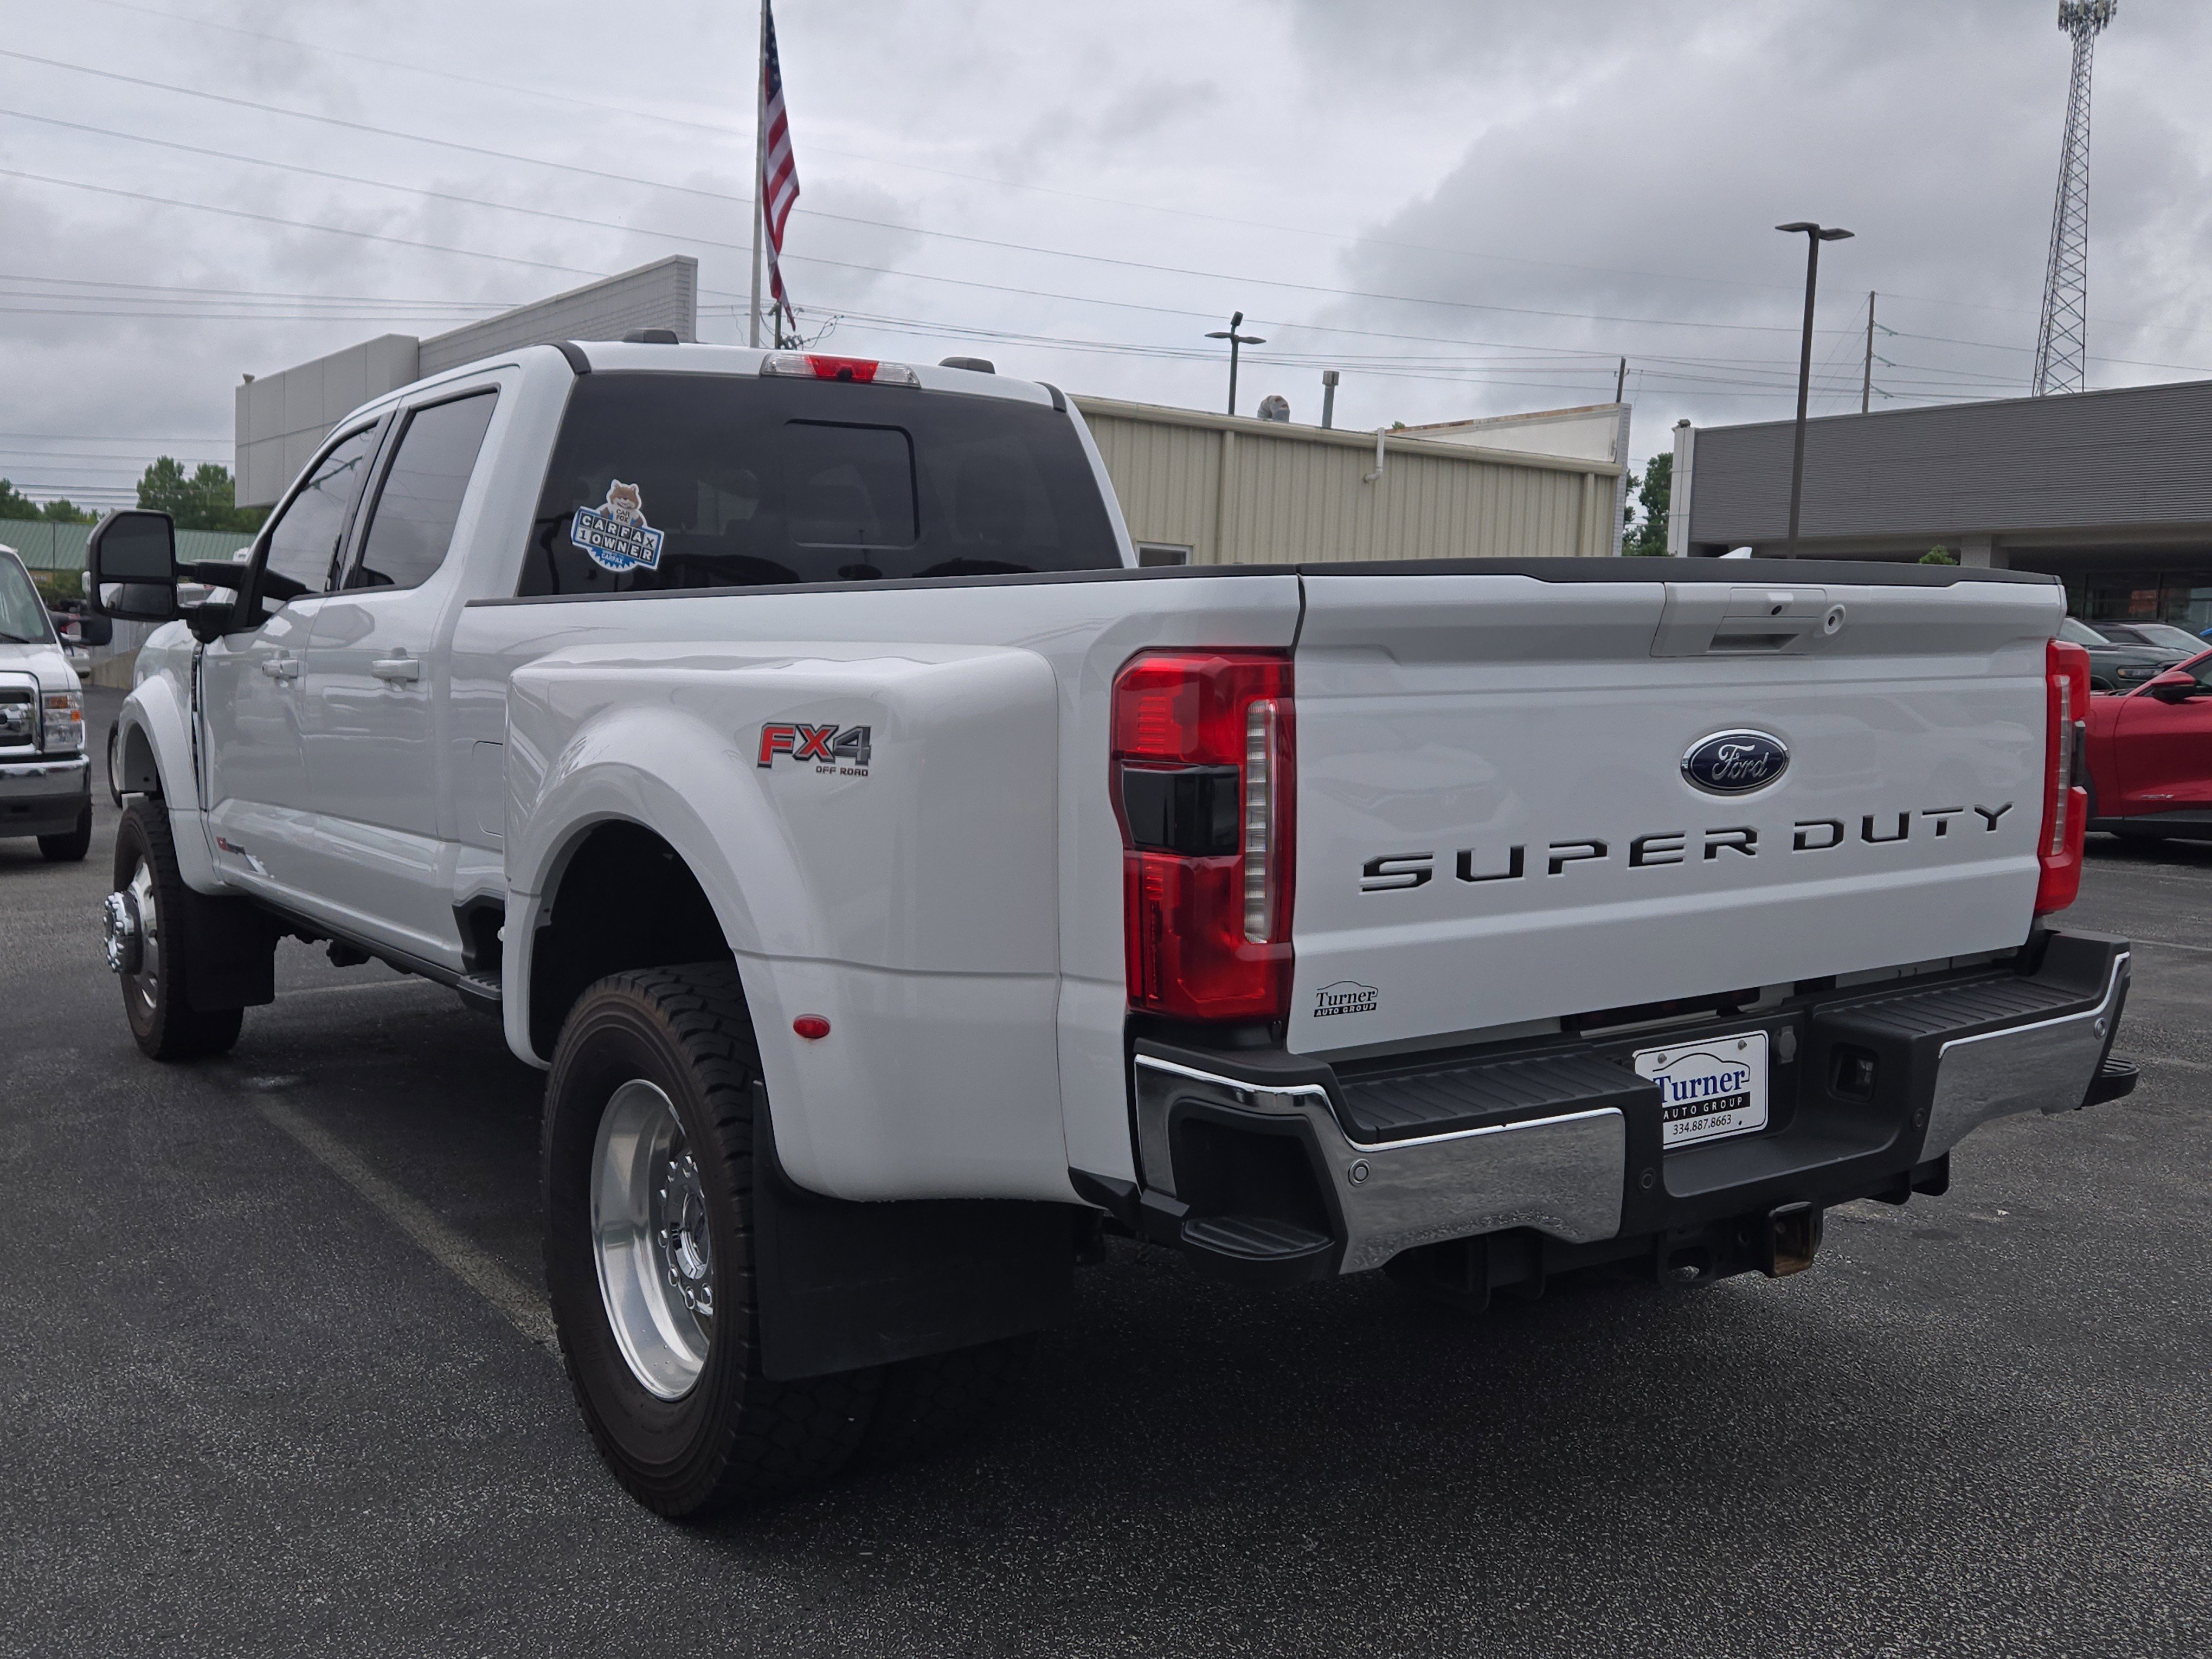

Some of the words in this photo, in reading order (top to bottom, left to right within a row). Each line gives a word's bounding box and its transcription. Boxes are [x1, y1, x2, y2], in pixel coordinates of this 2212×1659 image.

[616, 509, 629, 518] CAR
[616, 515, 628, 523] FOX
[582, 516, 654, 548] CARFAX
[579, 530, 587, 540] 1
[592, 534, 652, 561] OWNER
[757, 722, 871, 769] FX4
[816, 766, 837, 774] OFF
[840, 768, 869, 776] ROAD
[1712, 744, 1769, 780] Ford
[1360, 825, 1760, 894] SUPER
[1792, 802, 2014, 853] DUTY
[1316, 991, 1375, 1007] Turner
[1316, 1008, 1339, 1016] AUTO
[1342, 1004, 1374, 1013] GROUP
[1652, 1070, 1745, 1103] Turner
[1663, 1105, 1696, 1120] AUTO
[1703, 1096, 1743, 1112] GROUP
[1673, 1114, 1732, 1135] 334.887.8663
